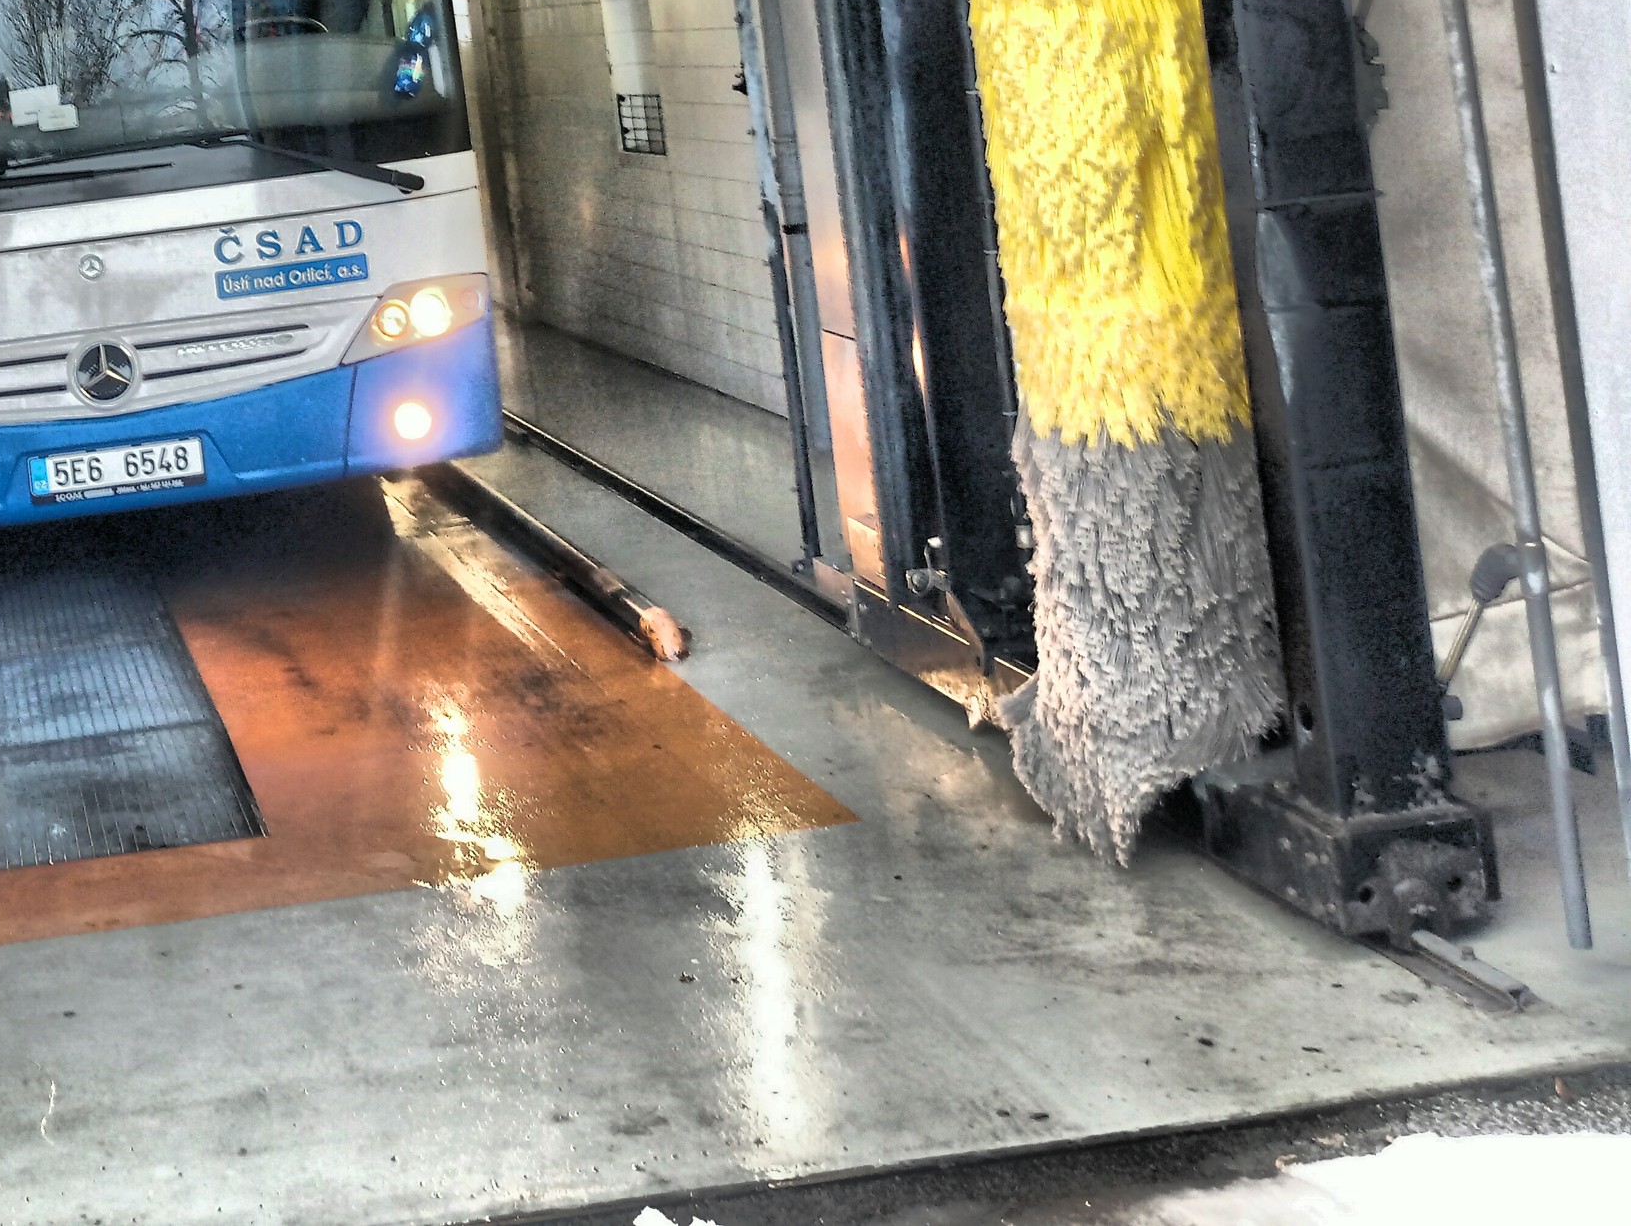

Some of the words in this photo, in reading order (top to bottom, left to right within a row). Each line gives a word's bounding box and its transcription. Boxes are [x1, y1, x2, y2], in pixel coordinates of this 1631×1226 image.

[214, 220, 363, 265] ČSAD
[222, 274, 251, 294] Ústí
[254, 271, 286, 289] nad
[289, 263, 335, 283] Orlicí,
[337, 263, 363, 278] a.s.
[53, 456, 103, 487] 5E6
[123, 445, 189, 478] 6548
